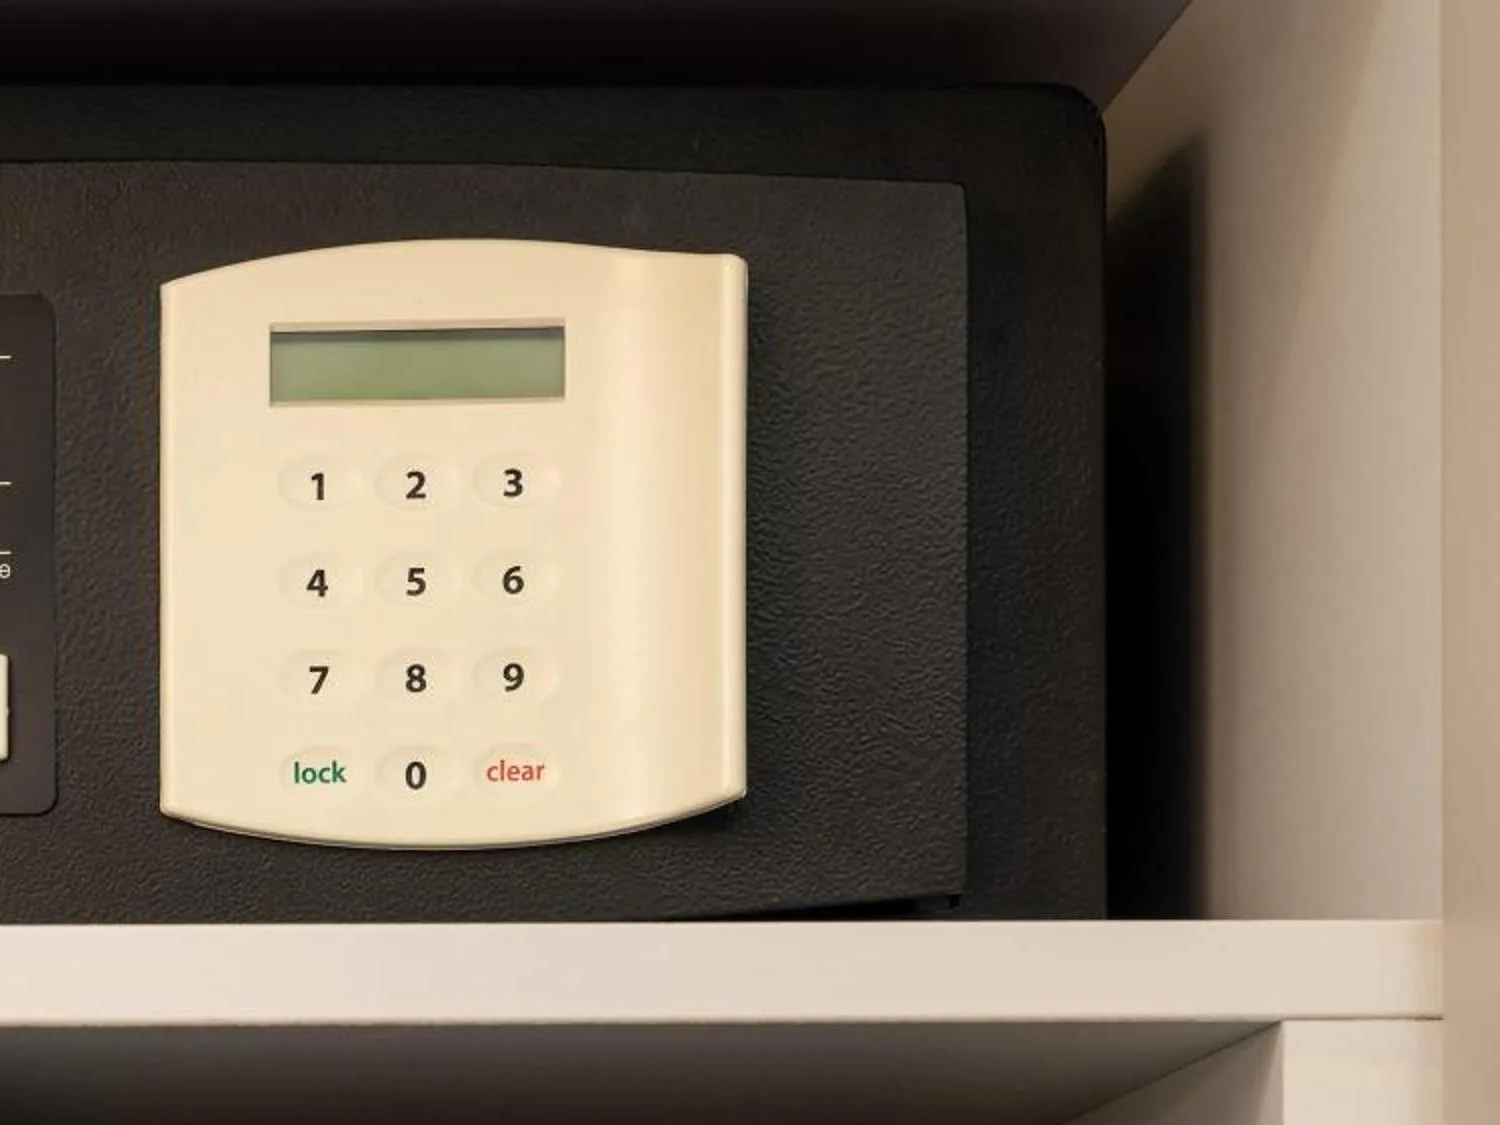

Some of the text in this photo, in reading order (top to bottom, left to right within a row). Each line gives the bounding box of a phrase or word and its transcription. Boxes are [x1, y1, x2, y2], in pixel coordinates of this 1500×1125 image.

[310, 472, 325, 501] 1
[405, 470, 427, 499] 2
[503, 468, 523, 497] 3
[306, 568, 329, 598] 4
[406, 566, 427, 596] 5
[502, 565, 525, 595] 6
[309, 666, 329, 694] 7
[405, 664, 427, 693] 8
[503, 662, 524, 692] 9
[294, 760, 347, 784] lock
[405, 761, 427, 790] 0
[486, 759, 545, 783] clear
